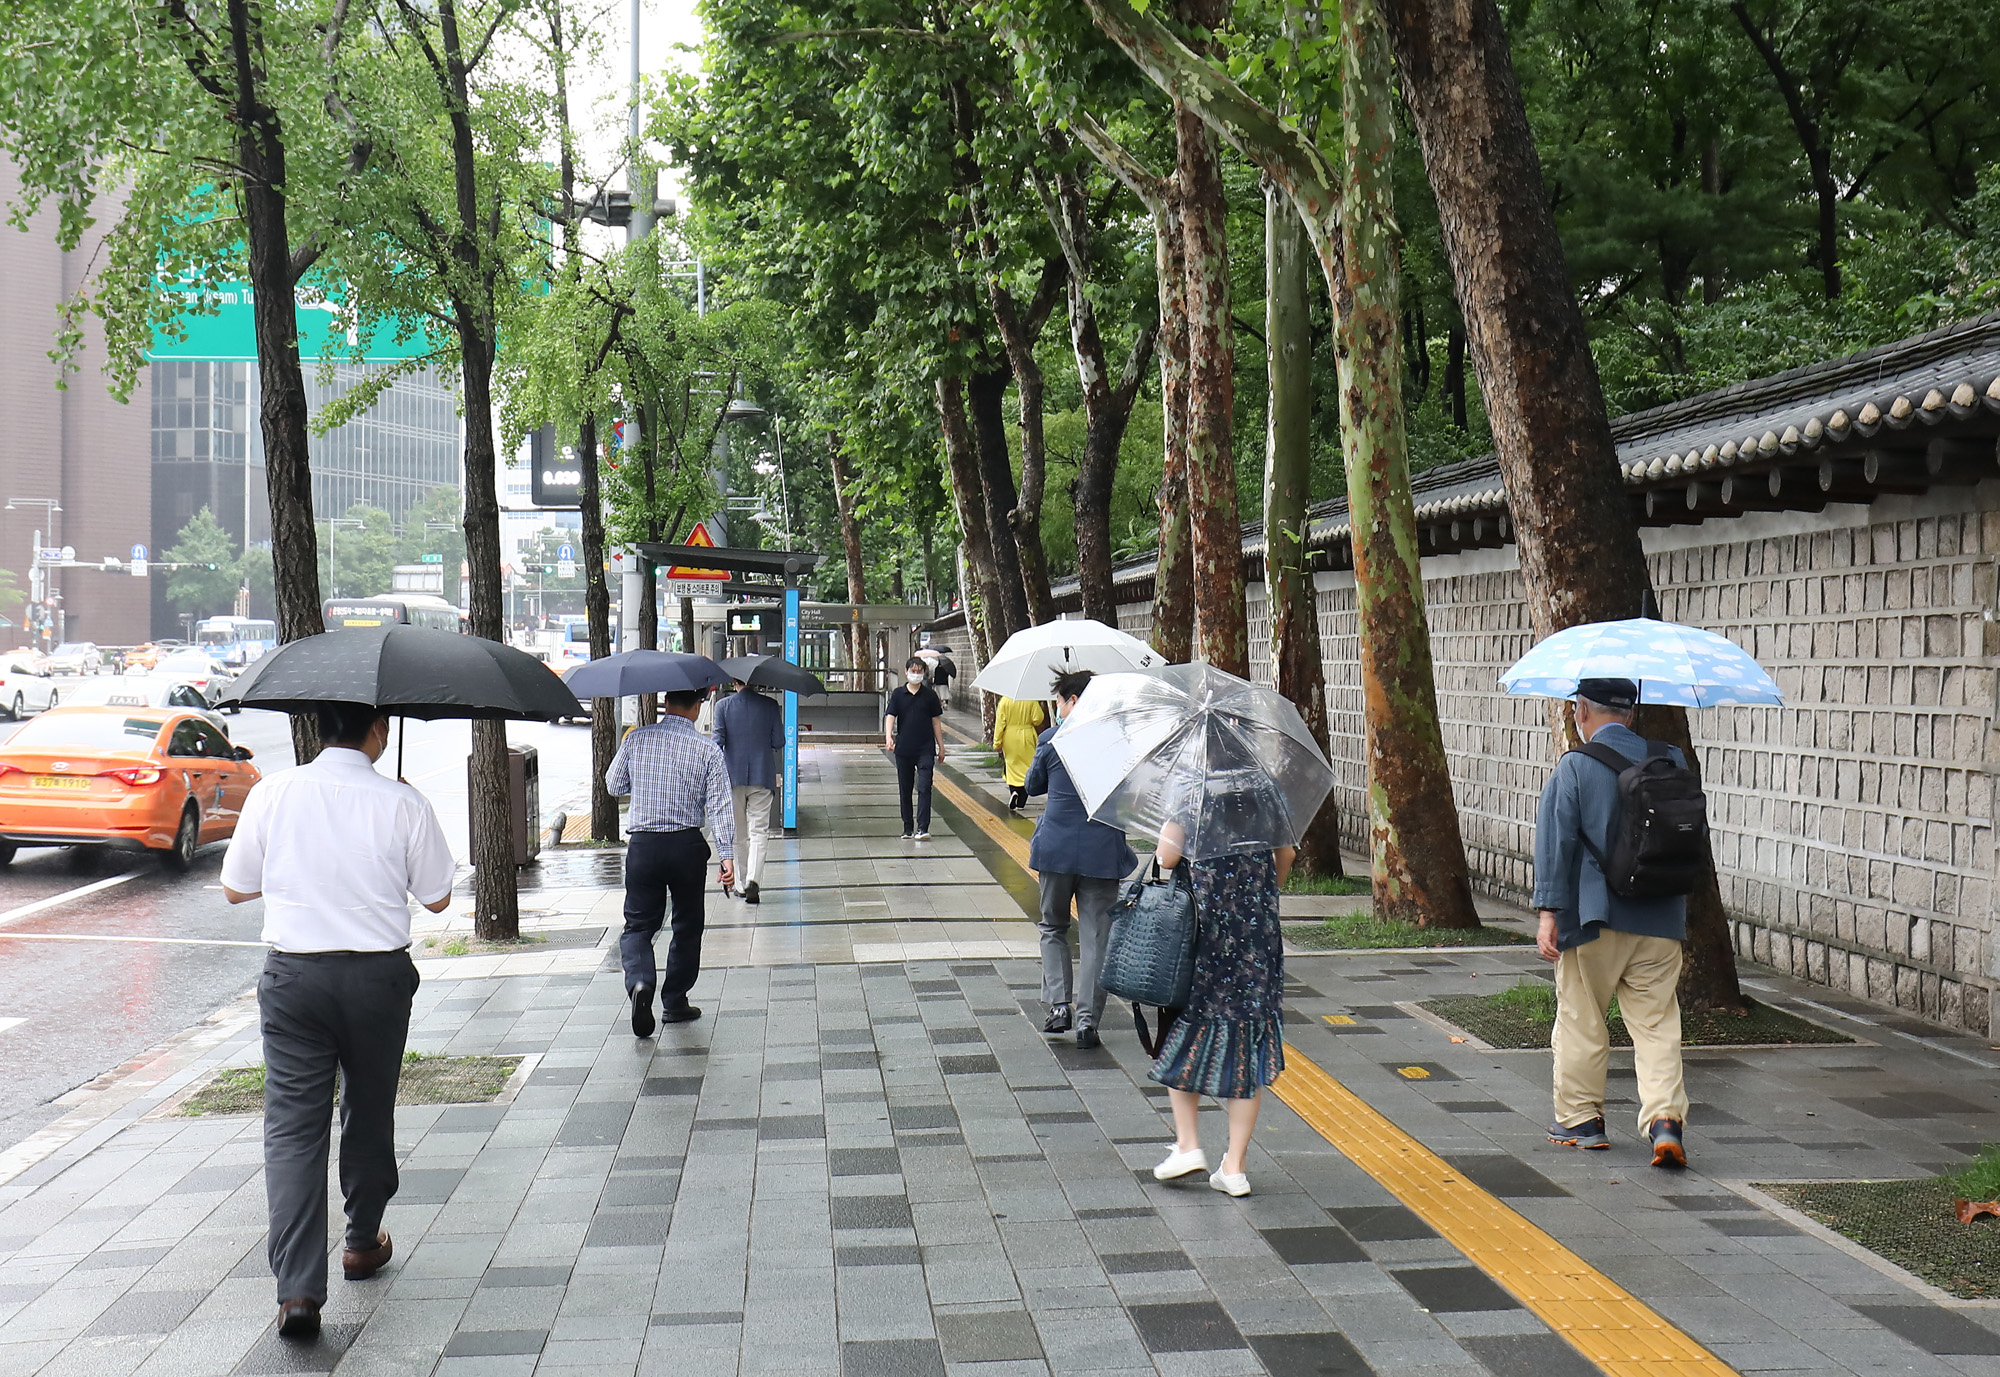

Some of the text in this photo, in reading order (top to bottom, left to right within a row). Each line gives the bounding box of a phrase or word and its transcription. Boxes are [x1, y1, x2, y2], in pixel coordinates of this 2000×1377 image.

[677, 583, 720, 594] 보행 중 스마트폰 주의
[852, 608, 858, 617] 3
[112, 696, 137, 704] TAXI
